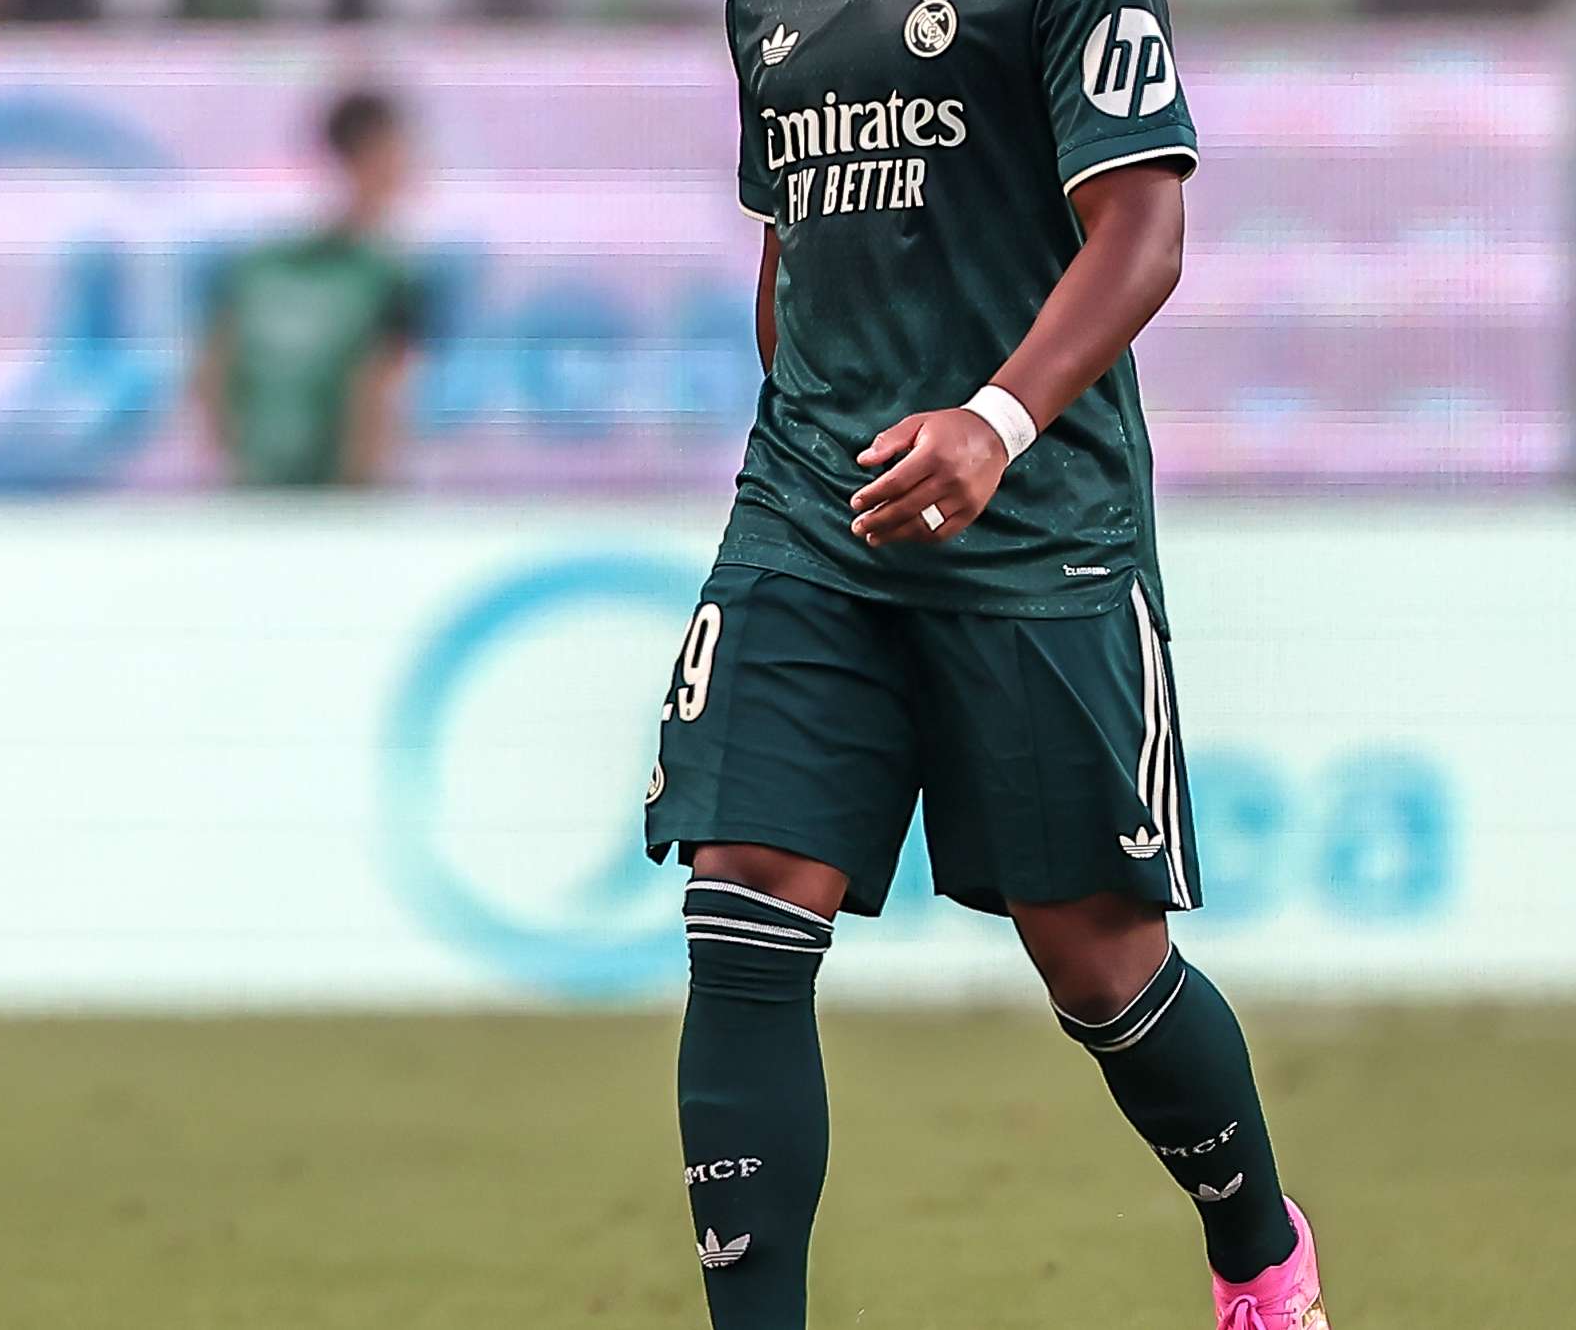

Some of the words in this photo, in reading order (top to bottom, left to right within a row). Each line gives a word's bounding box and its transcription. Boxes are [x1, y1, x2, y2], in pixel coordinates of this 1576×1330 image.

[1091, 8, 1167, 119] hp
[760, 89, 967, 170] Emirates
[822, 158, 926, 216] BETTER
[662, 602, 723, 722] 9
[1151, 1121, 1238, 1157] MCF
